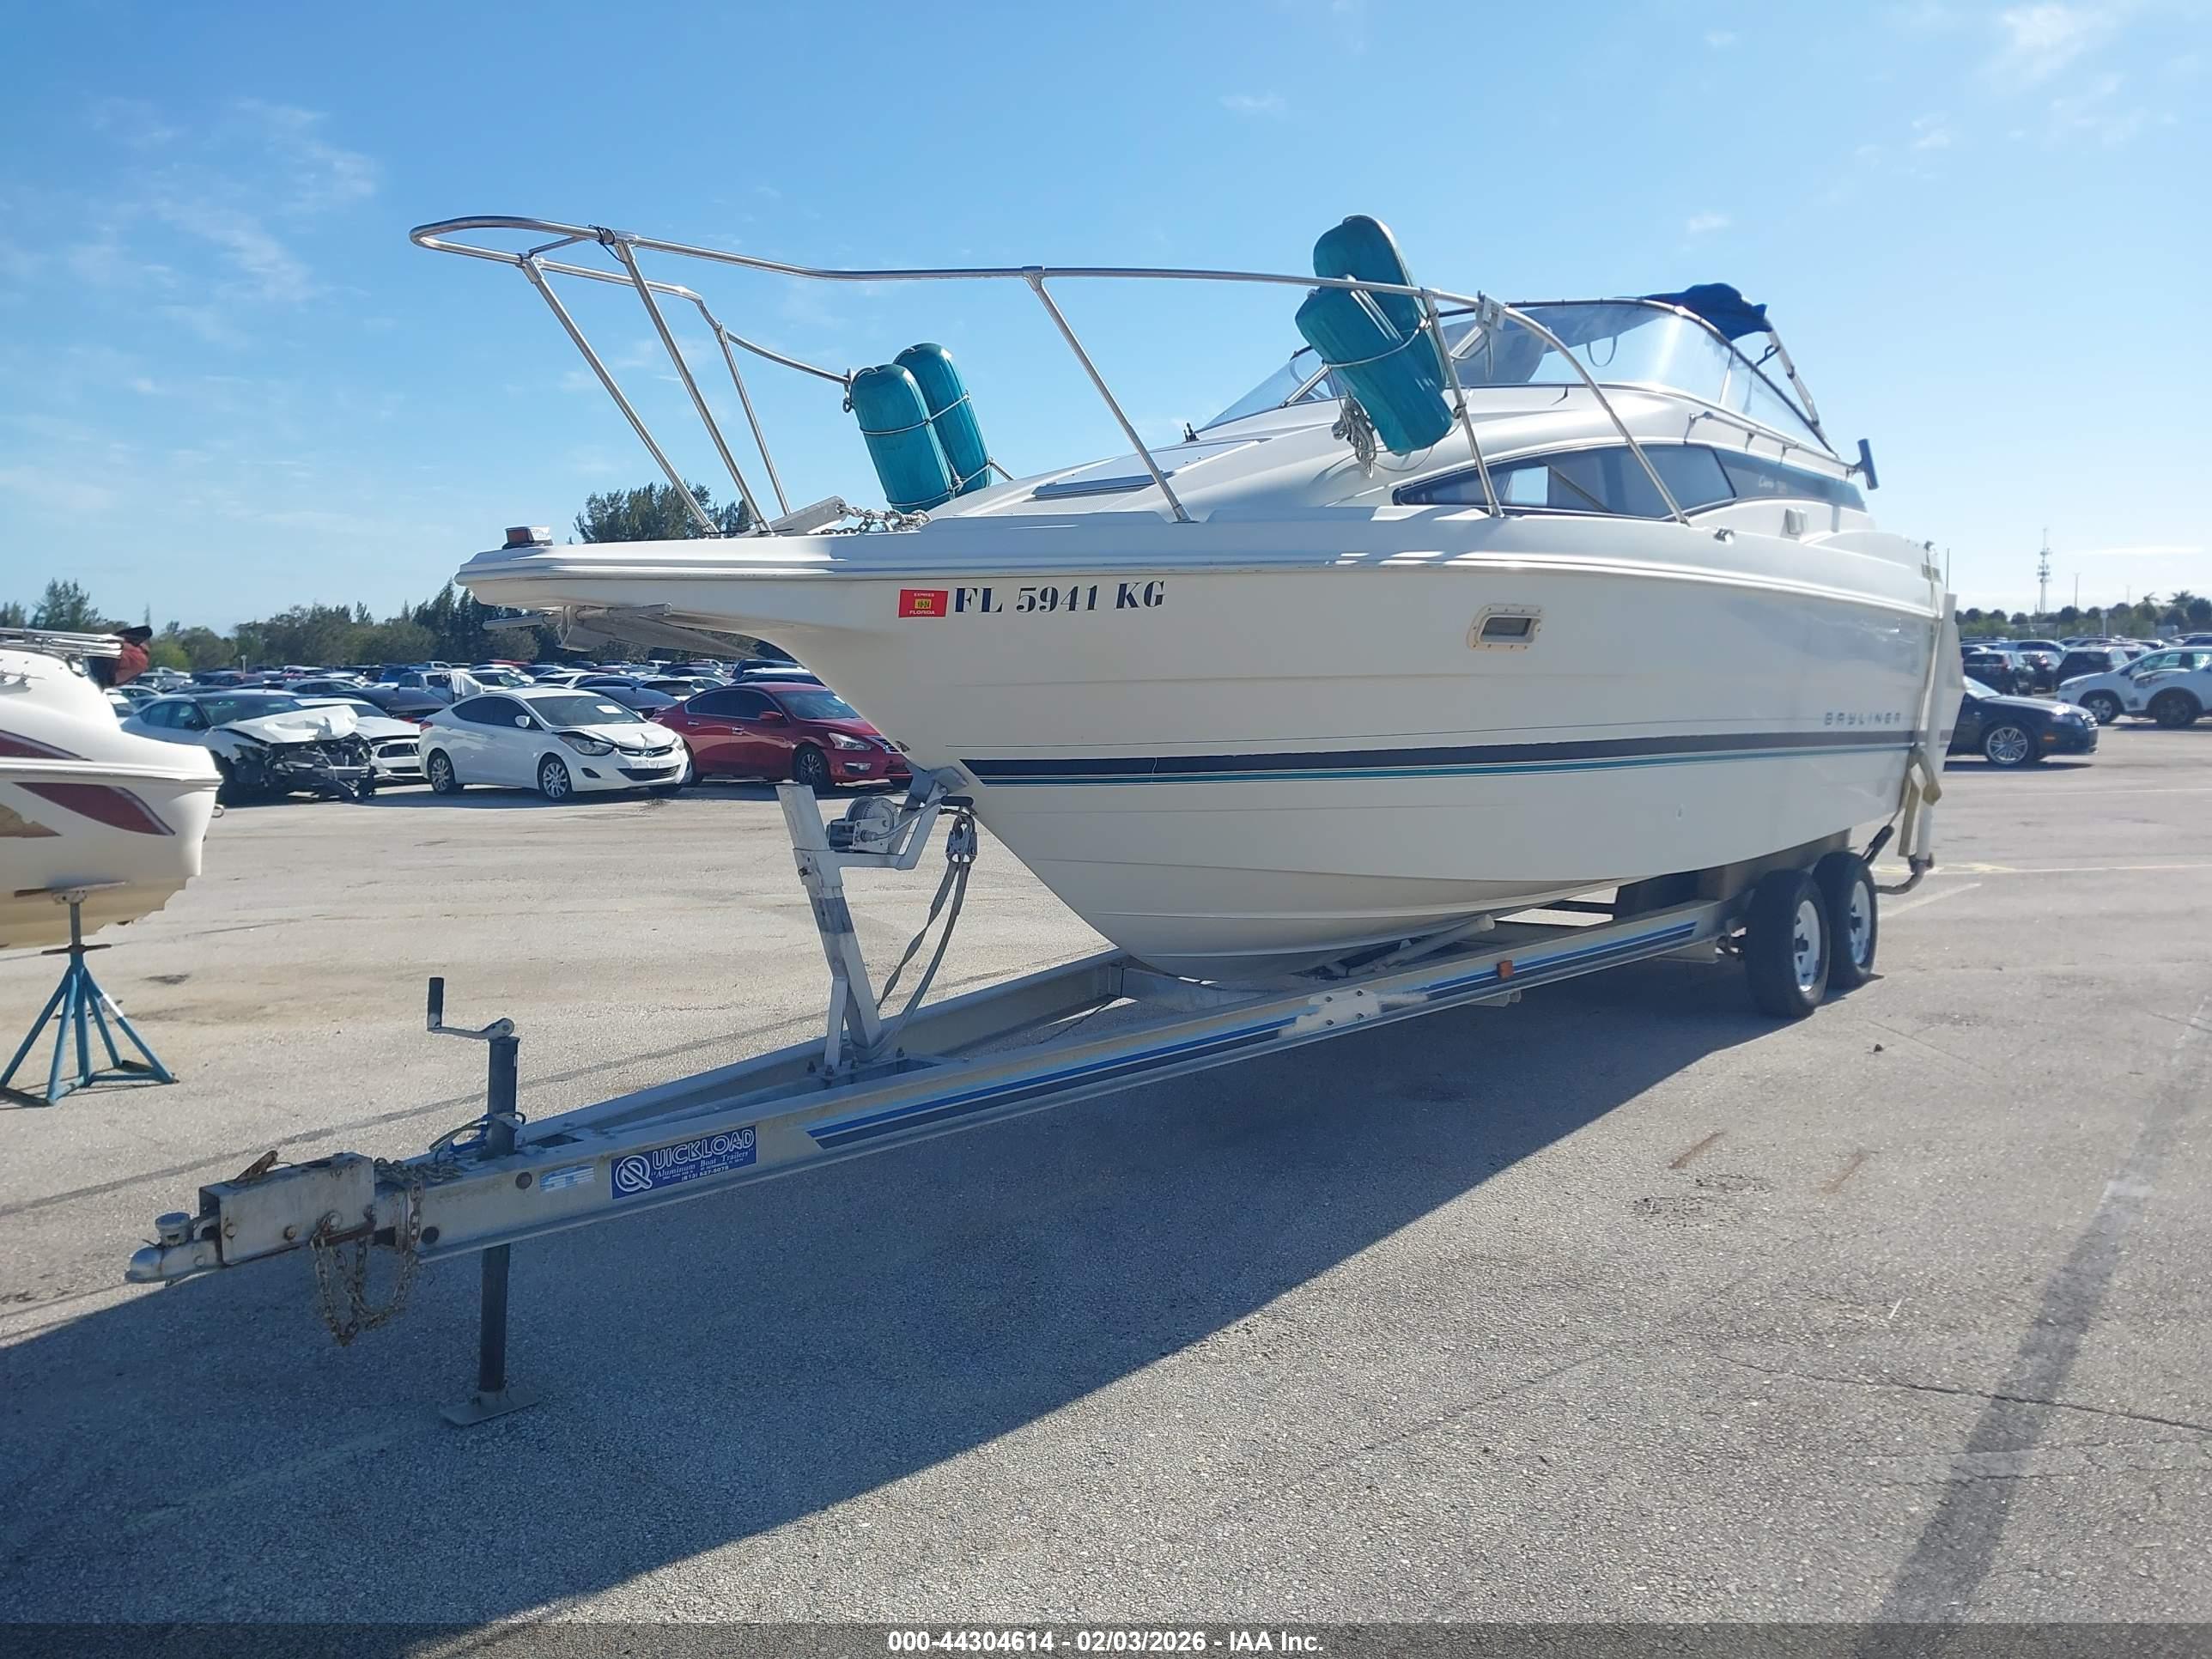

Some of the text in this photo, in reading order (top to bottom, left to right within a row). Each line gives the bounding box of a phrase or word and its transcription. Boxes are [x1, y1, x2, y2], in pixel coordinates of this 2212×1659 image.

[955, 580, 1165, 613] FL 5941 KG
[1824, 712, 1902, 726] BAYLINER
[700, 1158, 717, 1168] Boat
